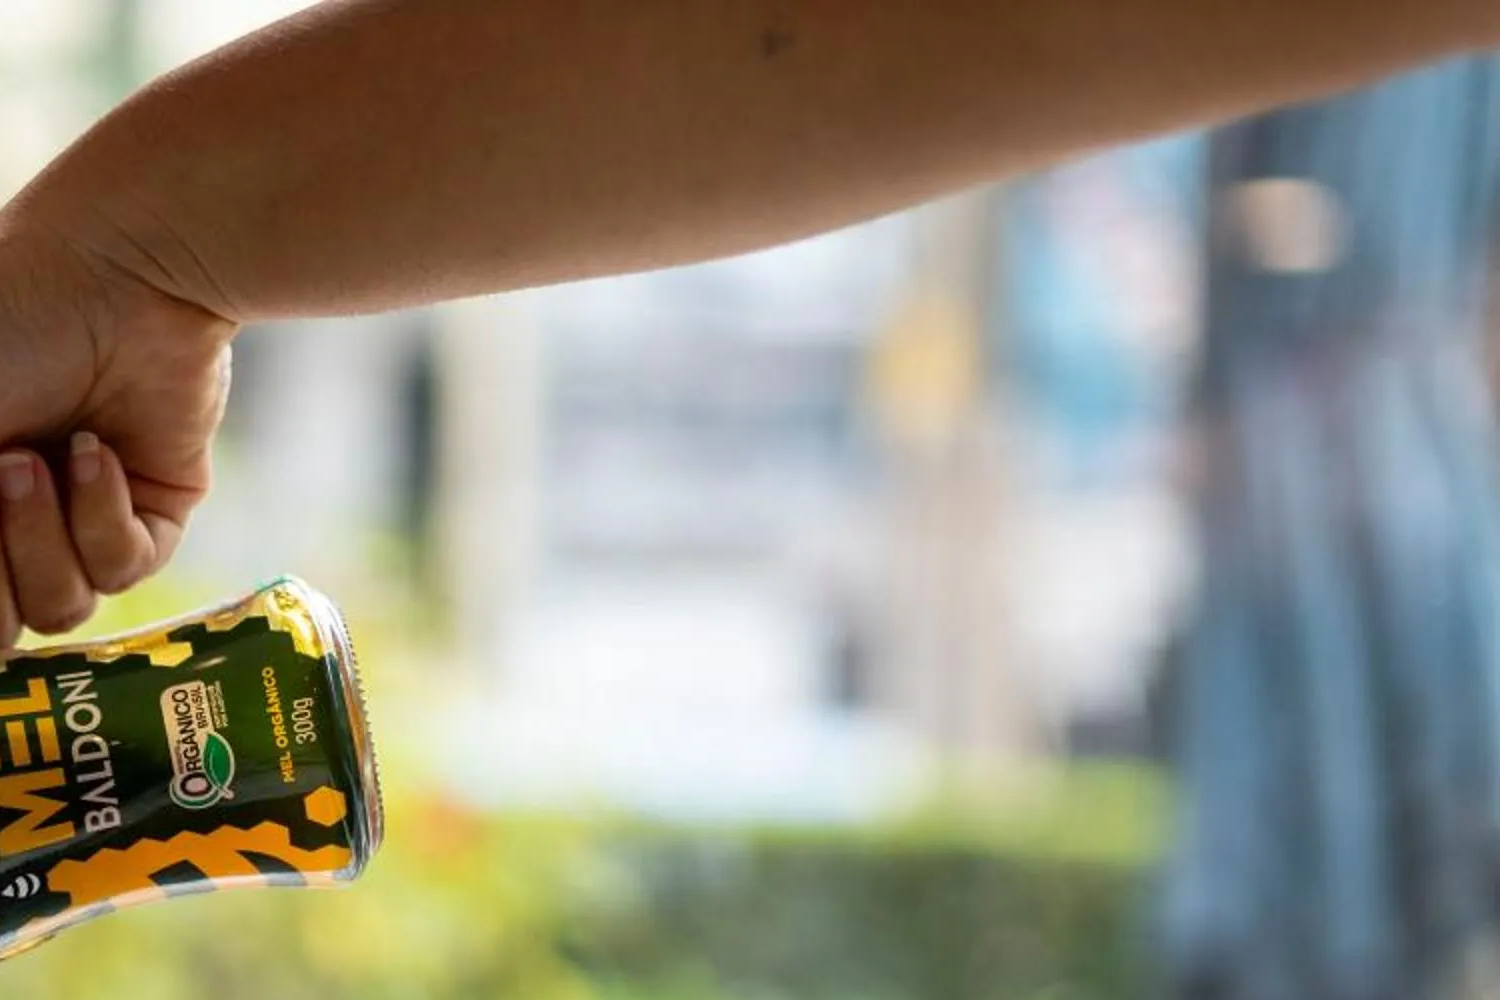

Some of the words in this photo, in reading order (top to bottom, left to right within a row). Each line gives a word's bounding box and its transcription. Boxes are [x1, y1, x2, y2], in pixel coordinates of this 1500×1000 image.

[190, 685, 208, 729] BRASIL
[261, 666, 289, 748] ORGÂNICO
[291, 697, 317, 745] 300g
[55, 670, 122, 833] BALDONI
[279, 751, 296, 783] MEL
